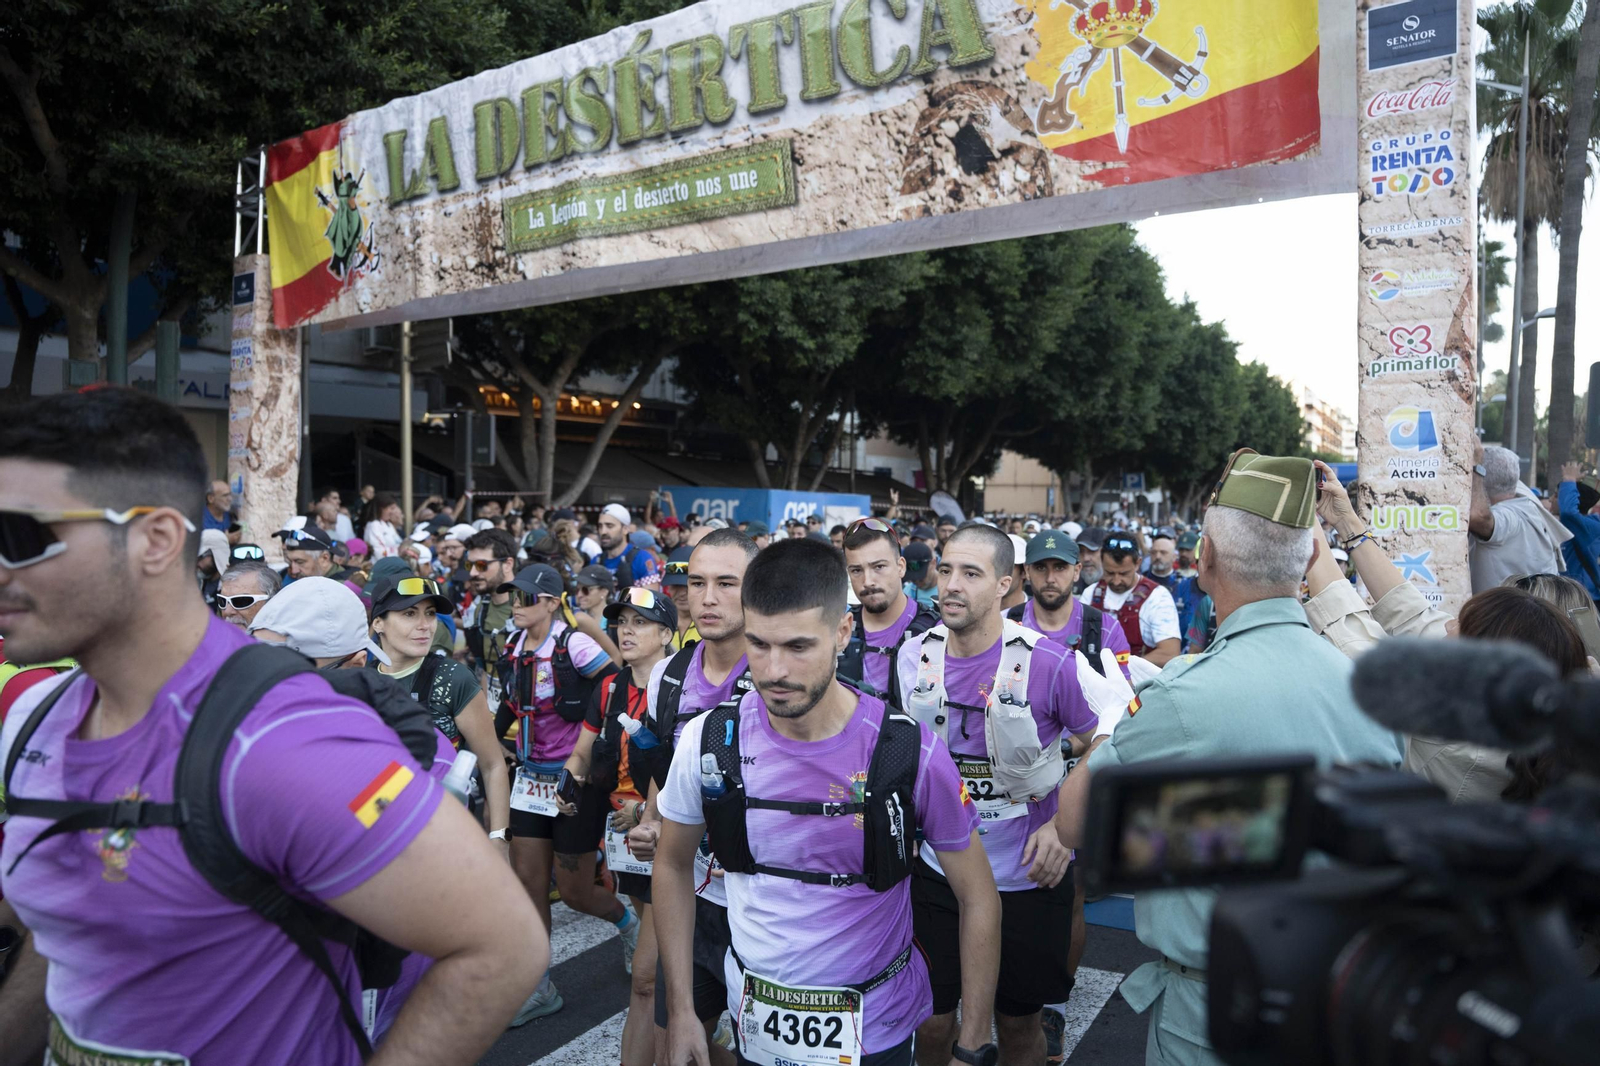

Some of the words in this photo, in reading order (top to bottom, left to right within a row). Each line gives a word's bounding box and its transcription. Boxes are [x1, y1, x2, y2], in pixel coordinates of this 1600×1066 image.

[1386, 29, 1437, 47] SENATOR
[384, 116, 461, 202] LA
[473, 0, 995, 181] DESÉRTICA
[1372, 131, 1451, 151] GRUPO
[1372, 145, 1454, 172] RENTA
[1372, 167, 1454, 195] TODO
[528, 207, 545, 229] La
[550, 196, 588, 226] Legión
[596, 198, 607, 220] y
[614, 188, 627, 214] el
[634, 181, 690, 210] desierto
[696, 175, 722, 197] nos
[728, 169, 758, 191] une
[1371, 355, 1458, 378] primaflor
[1387, 456, 1440, 468] Almería
[1391, 469, 1436, 479] Activa
[762, 984, 775, 999] LA
[763, 1010, 843, 1050] 4362
